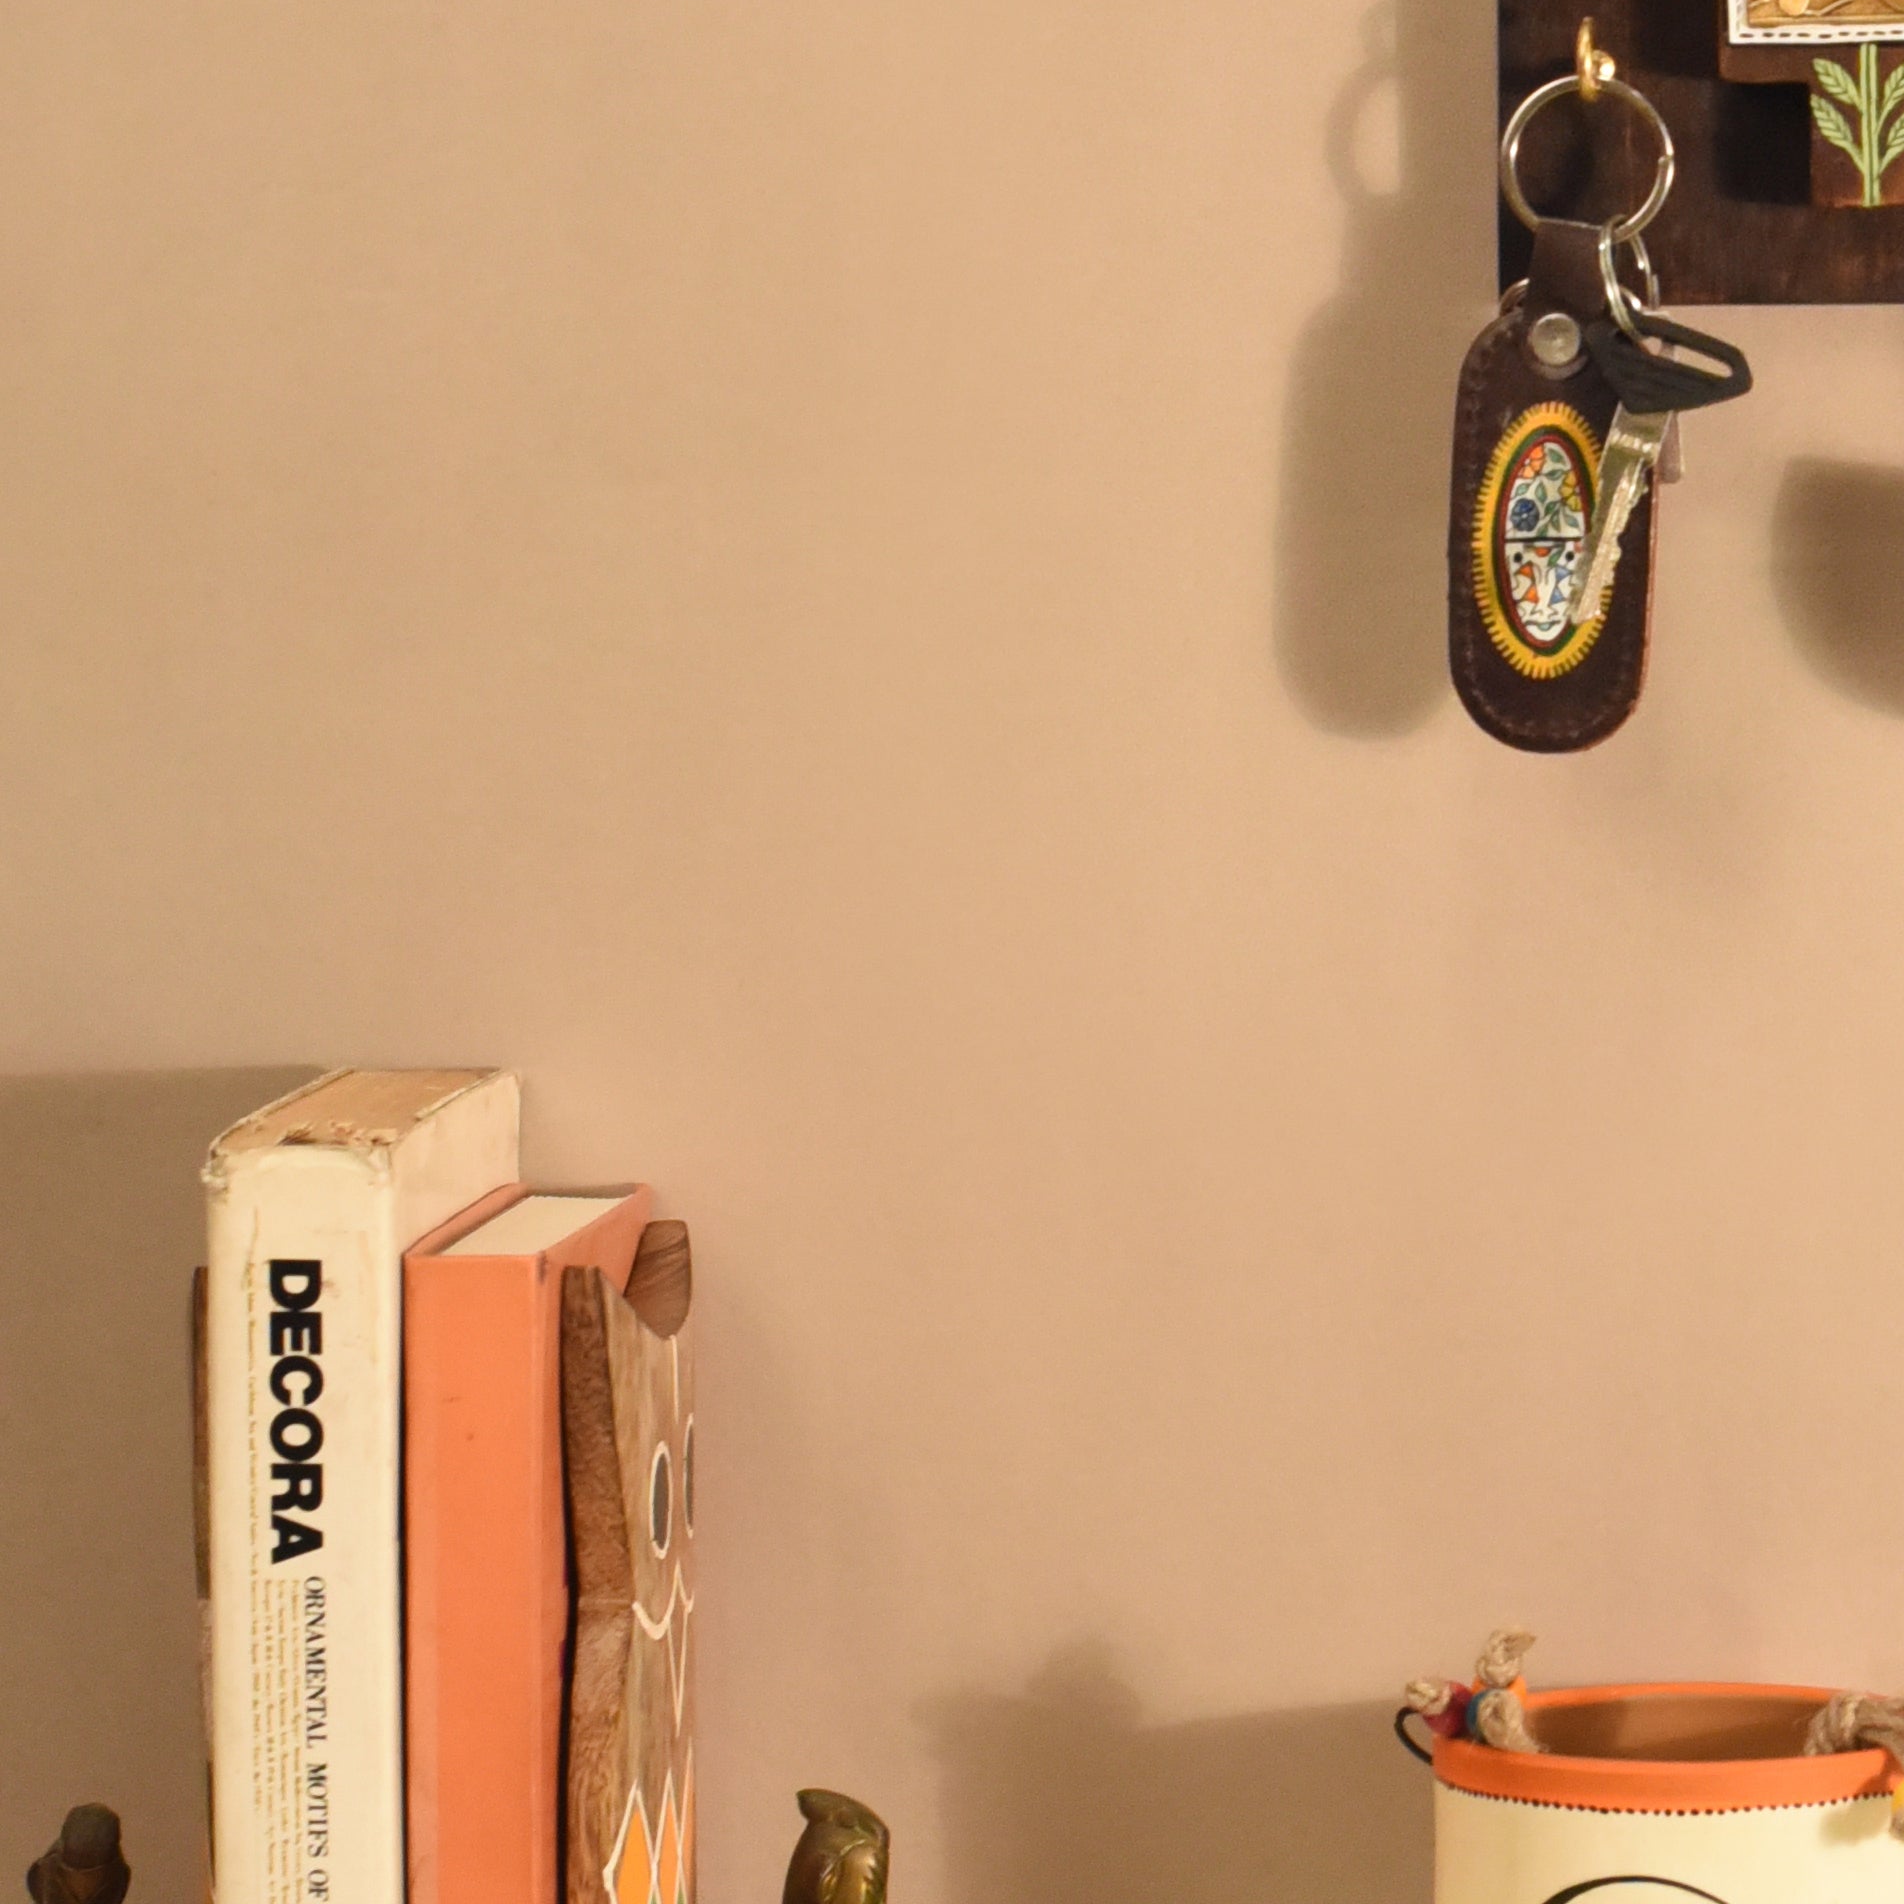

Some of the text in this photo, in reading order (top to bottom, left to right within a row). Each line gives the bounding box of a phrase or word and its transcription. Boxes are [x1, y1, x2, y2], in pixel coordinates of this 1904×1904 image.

[269, 1259, 324, 1565] DECORA
[304, 1575, 330, 1902] ORNAMENTAL MOTIFS OF
